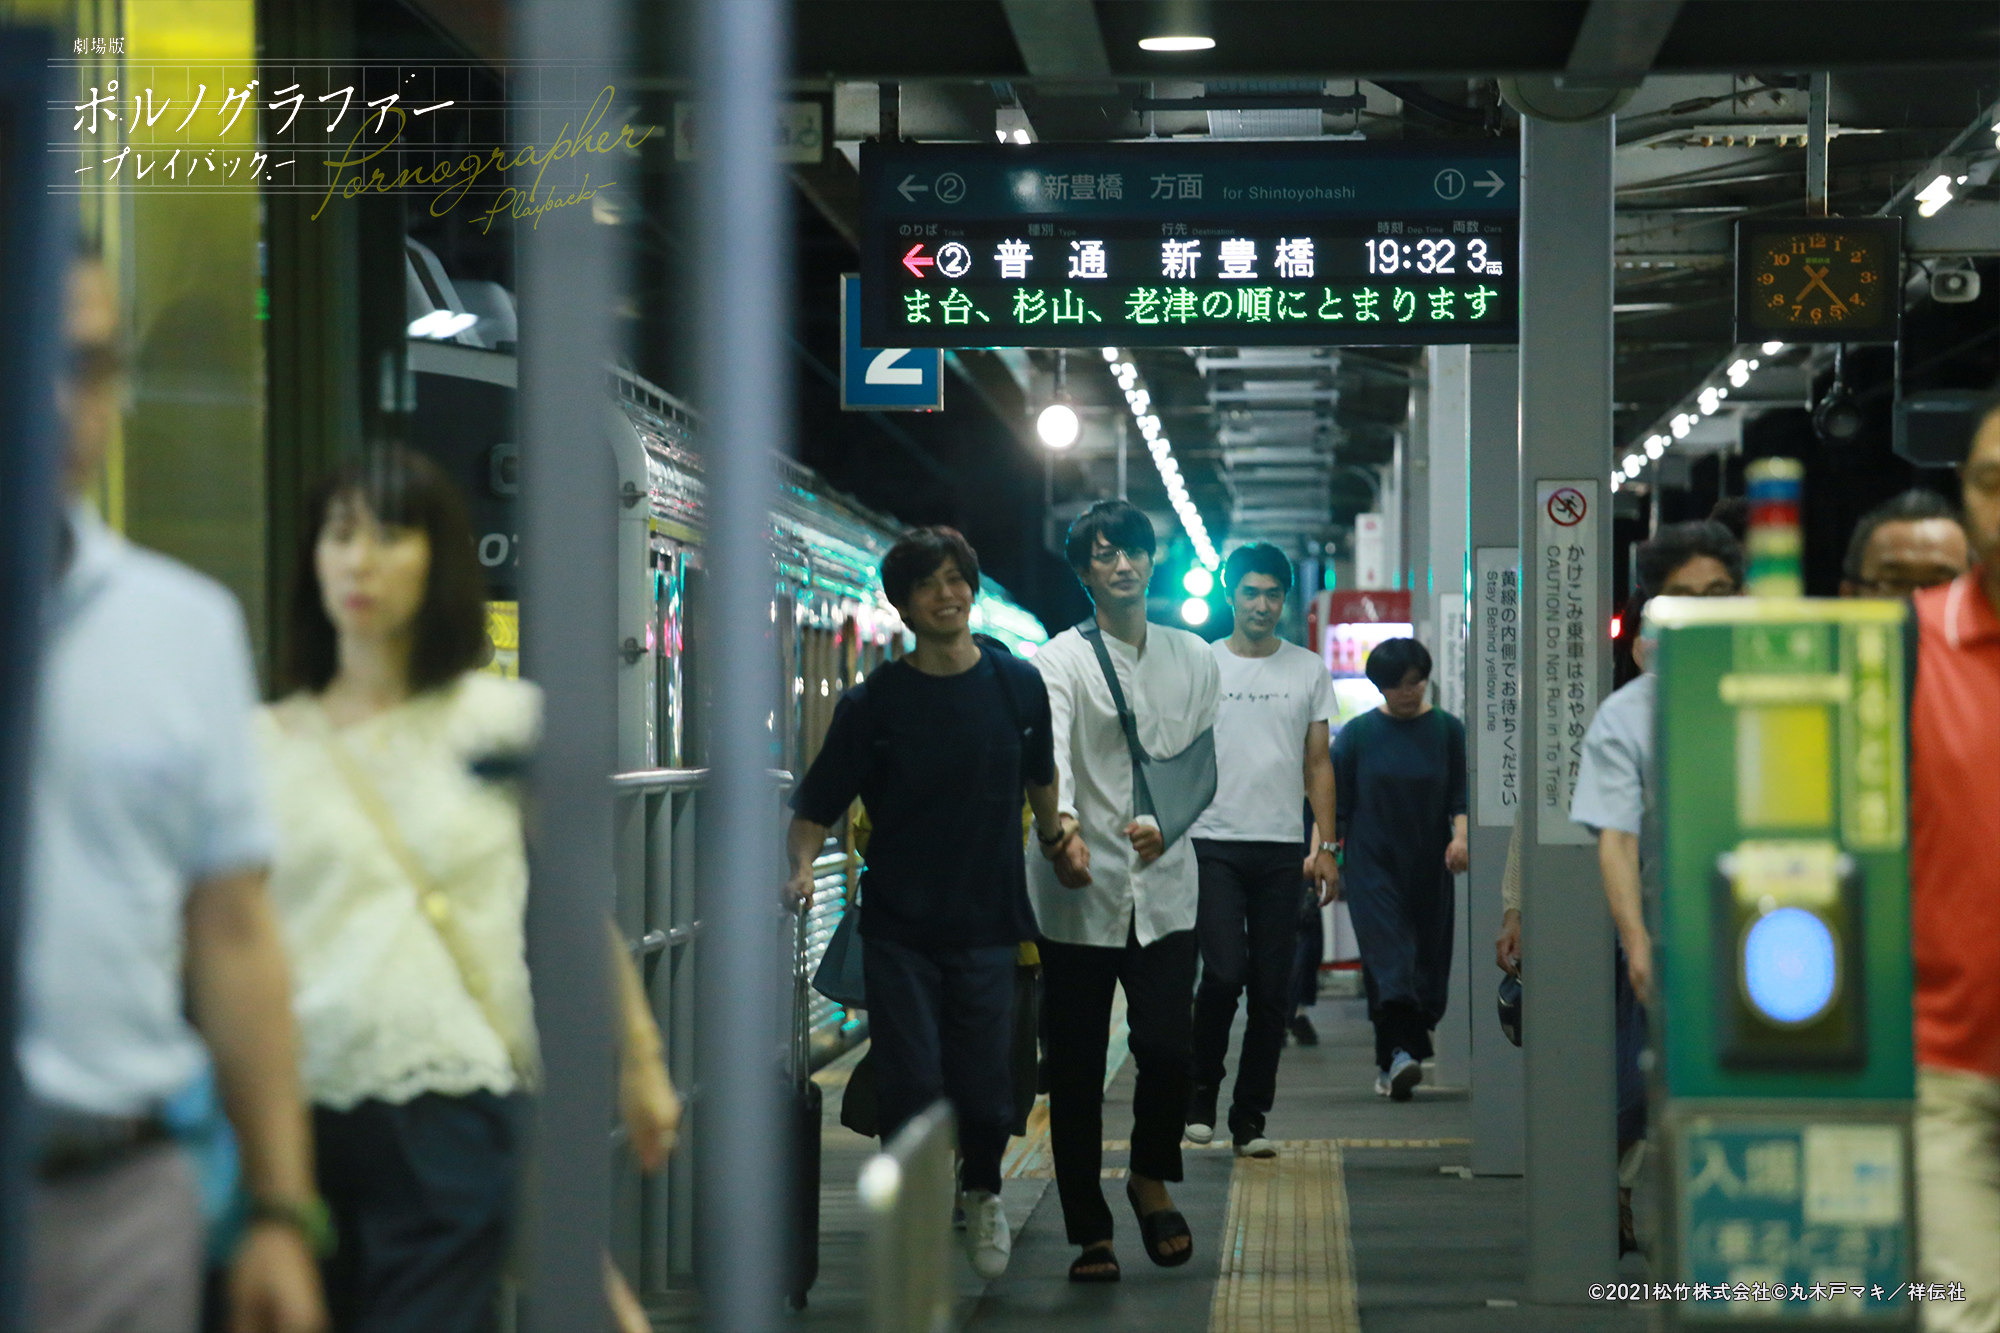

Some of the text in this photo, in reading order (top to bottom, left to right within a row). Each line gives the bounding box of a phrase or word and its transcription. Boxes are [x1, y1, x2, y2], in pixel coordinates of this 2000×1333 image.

[1044, 173, 1124, 201] 新豊橋
[1150, 173, 1204, 200] 方面
[1222, 186, 1243, 200] for
[1248, 186, 1356, 202] Shintoyohashi
[899, 223, 938, 237] のりば
[1028, 223, 1054, 237] 種別
[1161, 222, 1188, 236] 行先
[1192, 227, 1235, 236] Destination
[1377, 221, 1404, 235] 時刻
[1453, 221, 1479, 234] 両数
[1791, 242, 1806, 254] 11
[1809, 236, 1826, 248] 12
[1834, 240, 1841, 251] 1
[1365, 239, 1456, 275] 19:32
[1773, 254, 1790, 266] 10
[1850, 252, 1862, 263] 2
[1762, 273, 1775, 285] 9
[1860, 272, 1872, 284] 3
[1773, 294, 1784, 306] 8
[1849, 293, 1861, 304] 4
[1792, 305, 1803, 317] 7
[1810, 308, 1822, 320] 6
[1486, 570, 1498, 731] Stay Behind yellow Line
[1545, 545, 1560, 808] CAUTION Do Not Run in To Train
